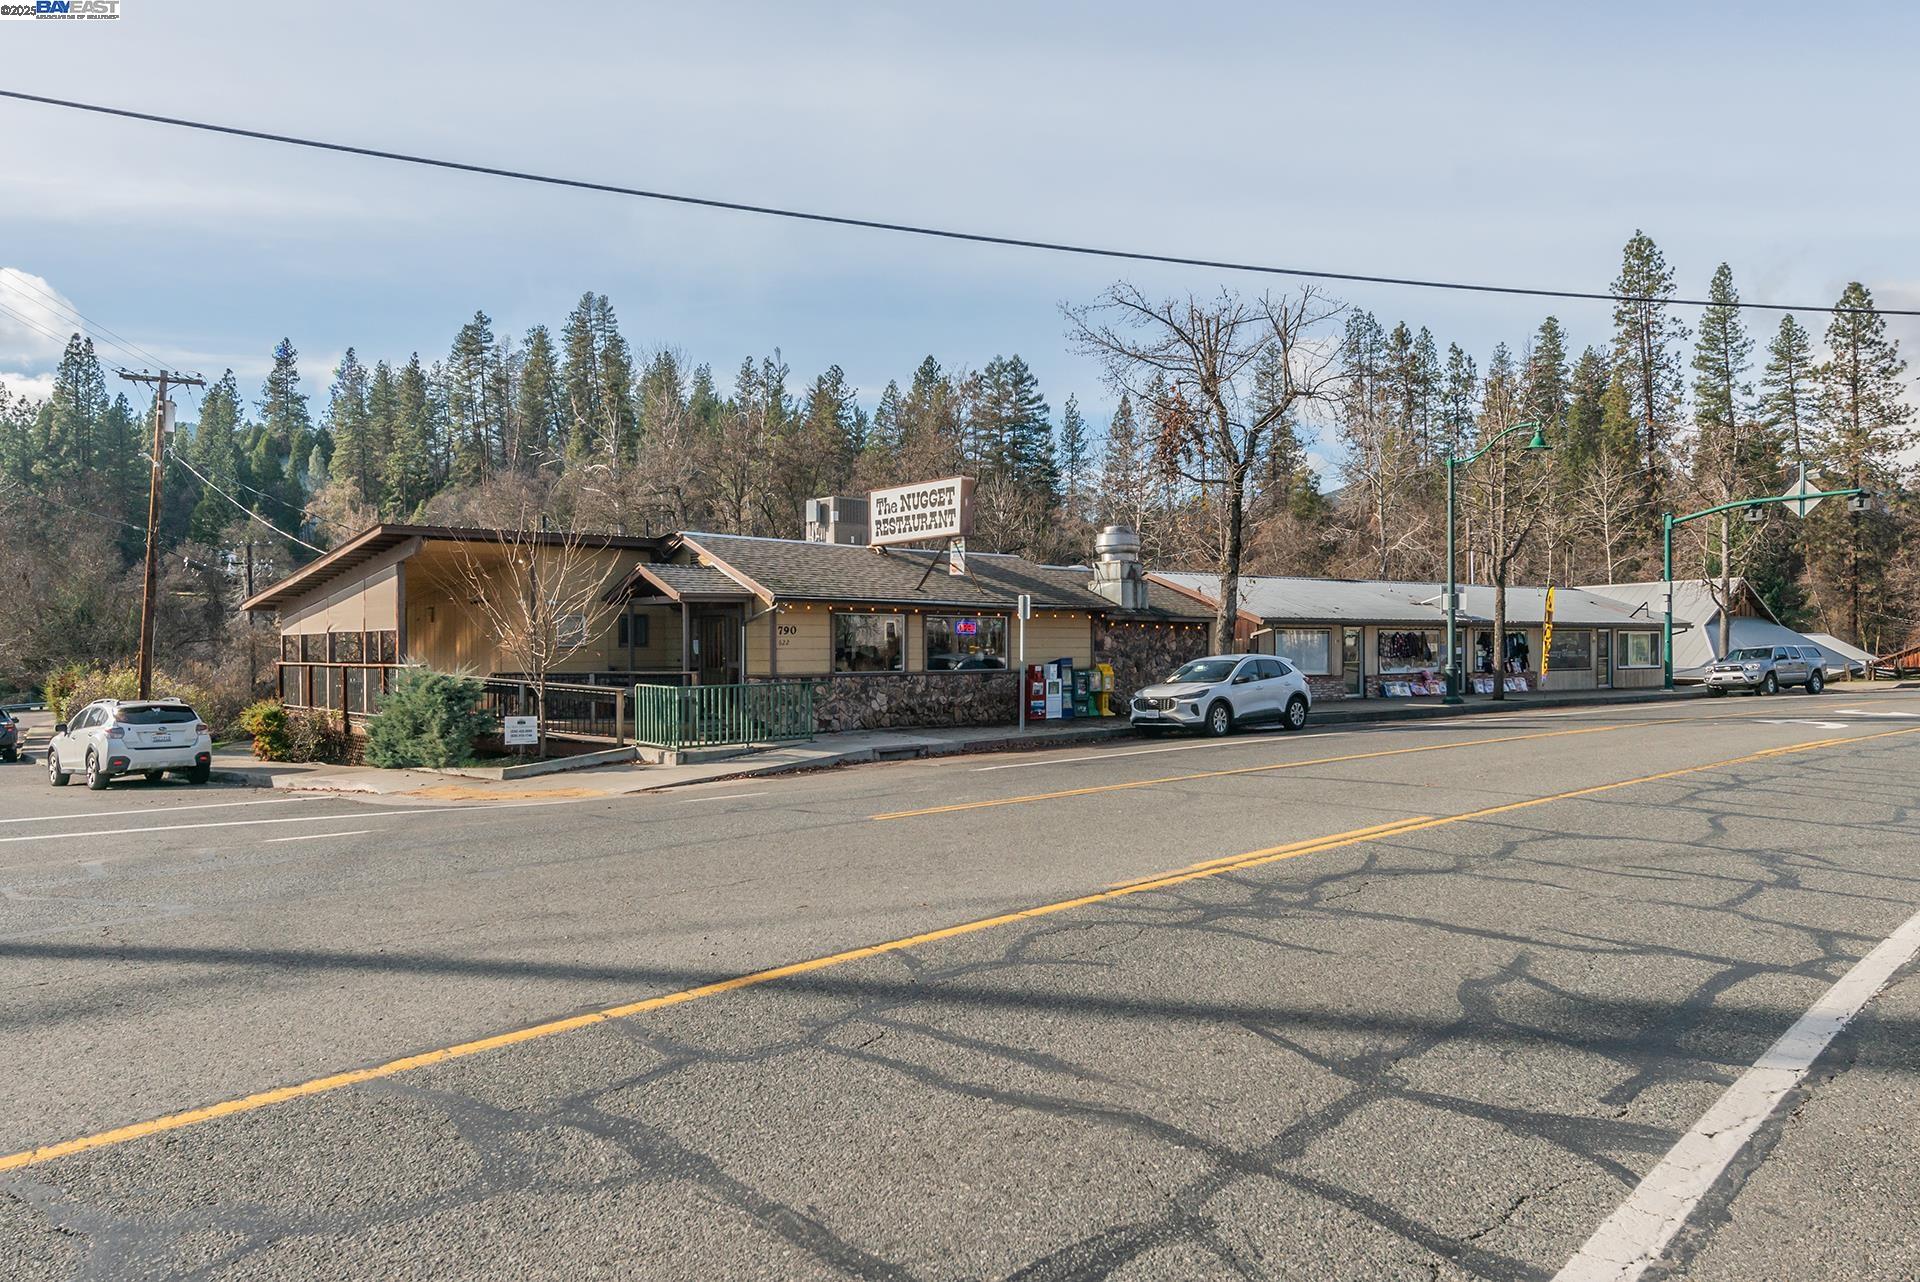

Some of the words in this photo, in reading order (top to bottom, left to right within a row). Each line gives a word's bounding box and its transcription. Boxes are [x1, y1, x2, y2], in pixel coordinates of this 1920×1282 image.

[876, 497, 898, 515] The
[900, 486, 956, 513] NUGGET
[875, 508, 956, 537] RESTAURANT
[777, 625, 797, 635] 790
